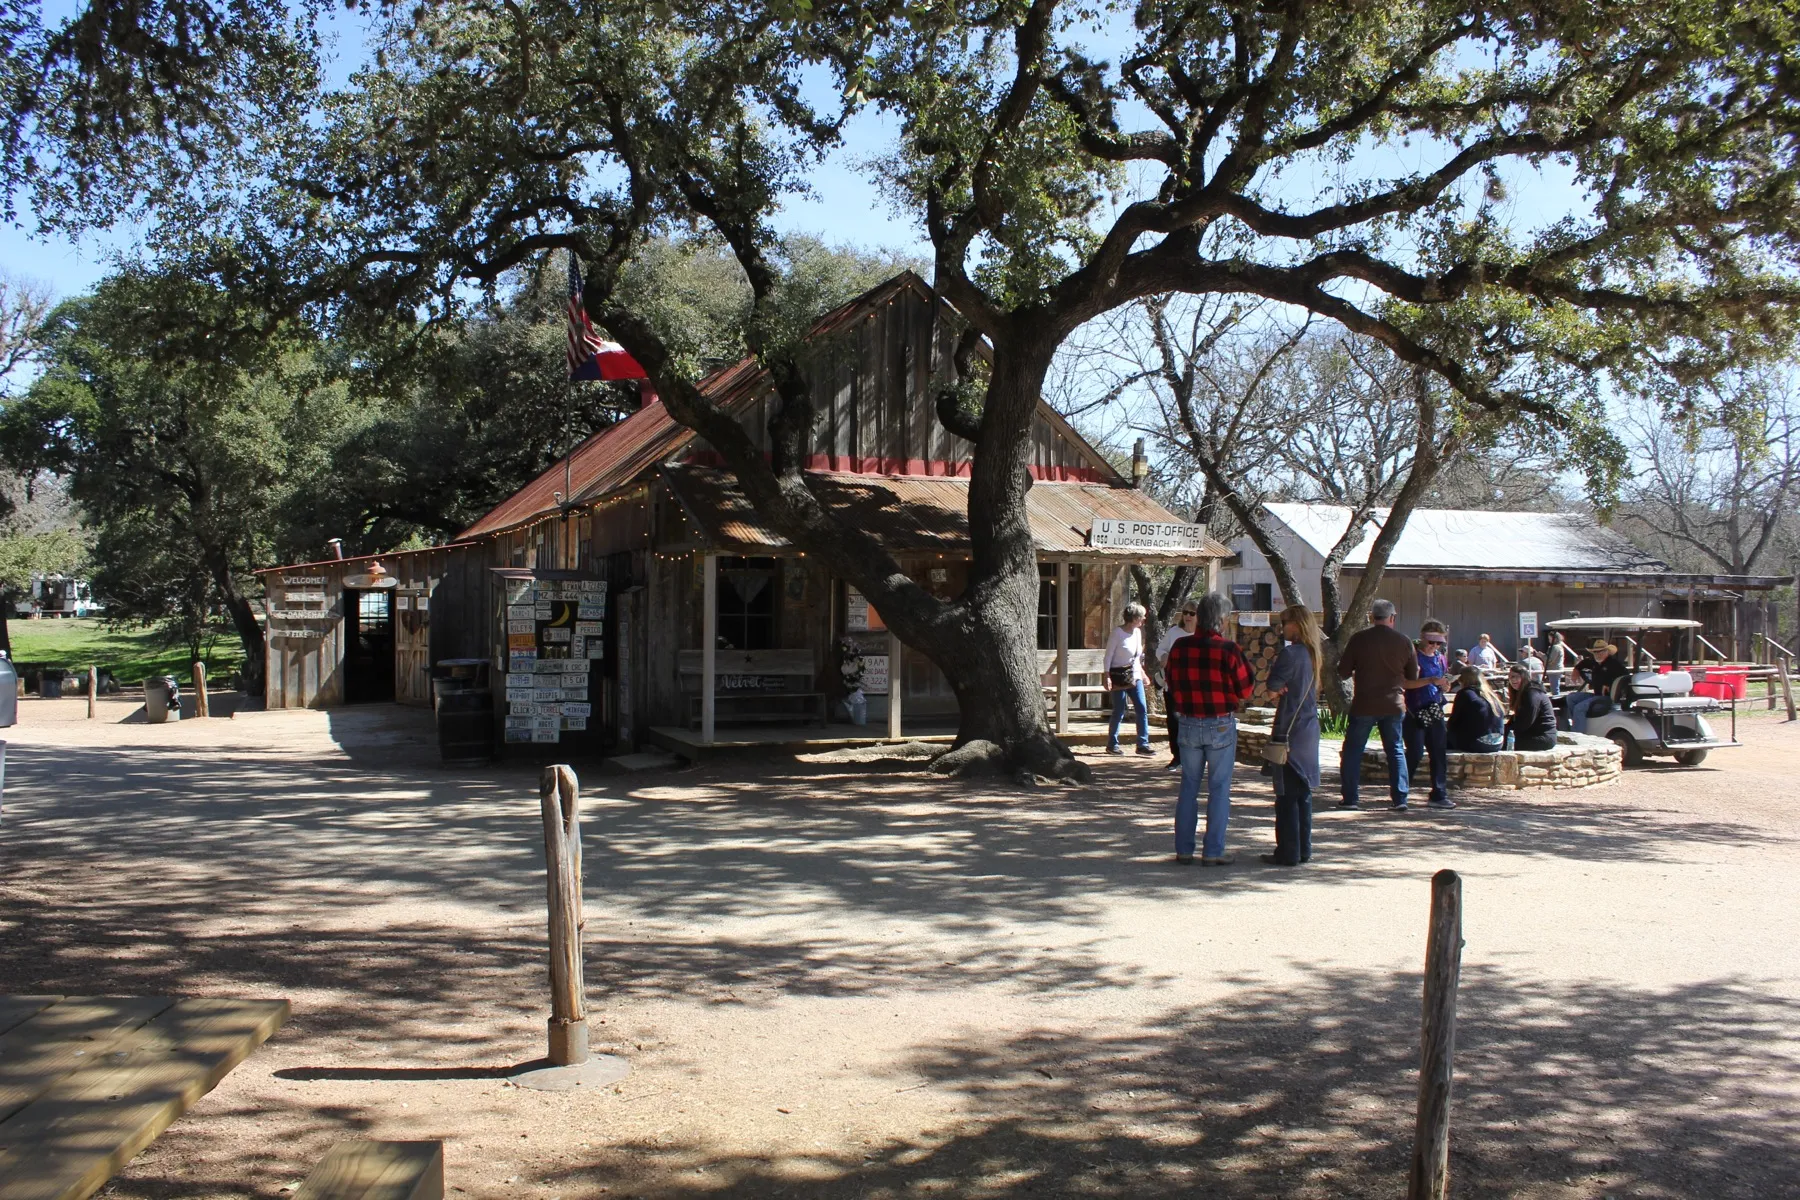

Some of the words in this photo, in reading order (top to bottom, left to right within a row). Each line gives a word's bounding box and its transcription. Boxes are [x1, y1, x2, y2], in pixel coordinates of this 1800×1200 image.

[1133, 524, 1200, 538] POST-OFFICE
[282, 577, 325, 585] WELCOME!
[565, 592, 578, 600] 444
